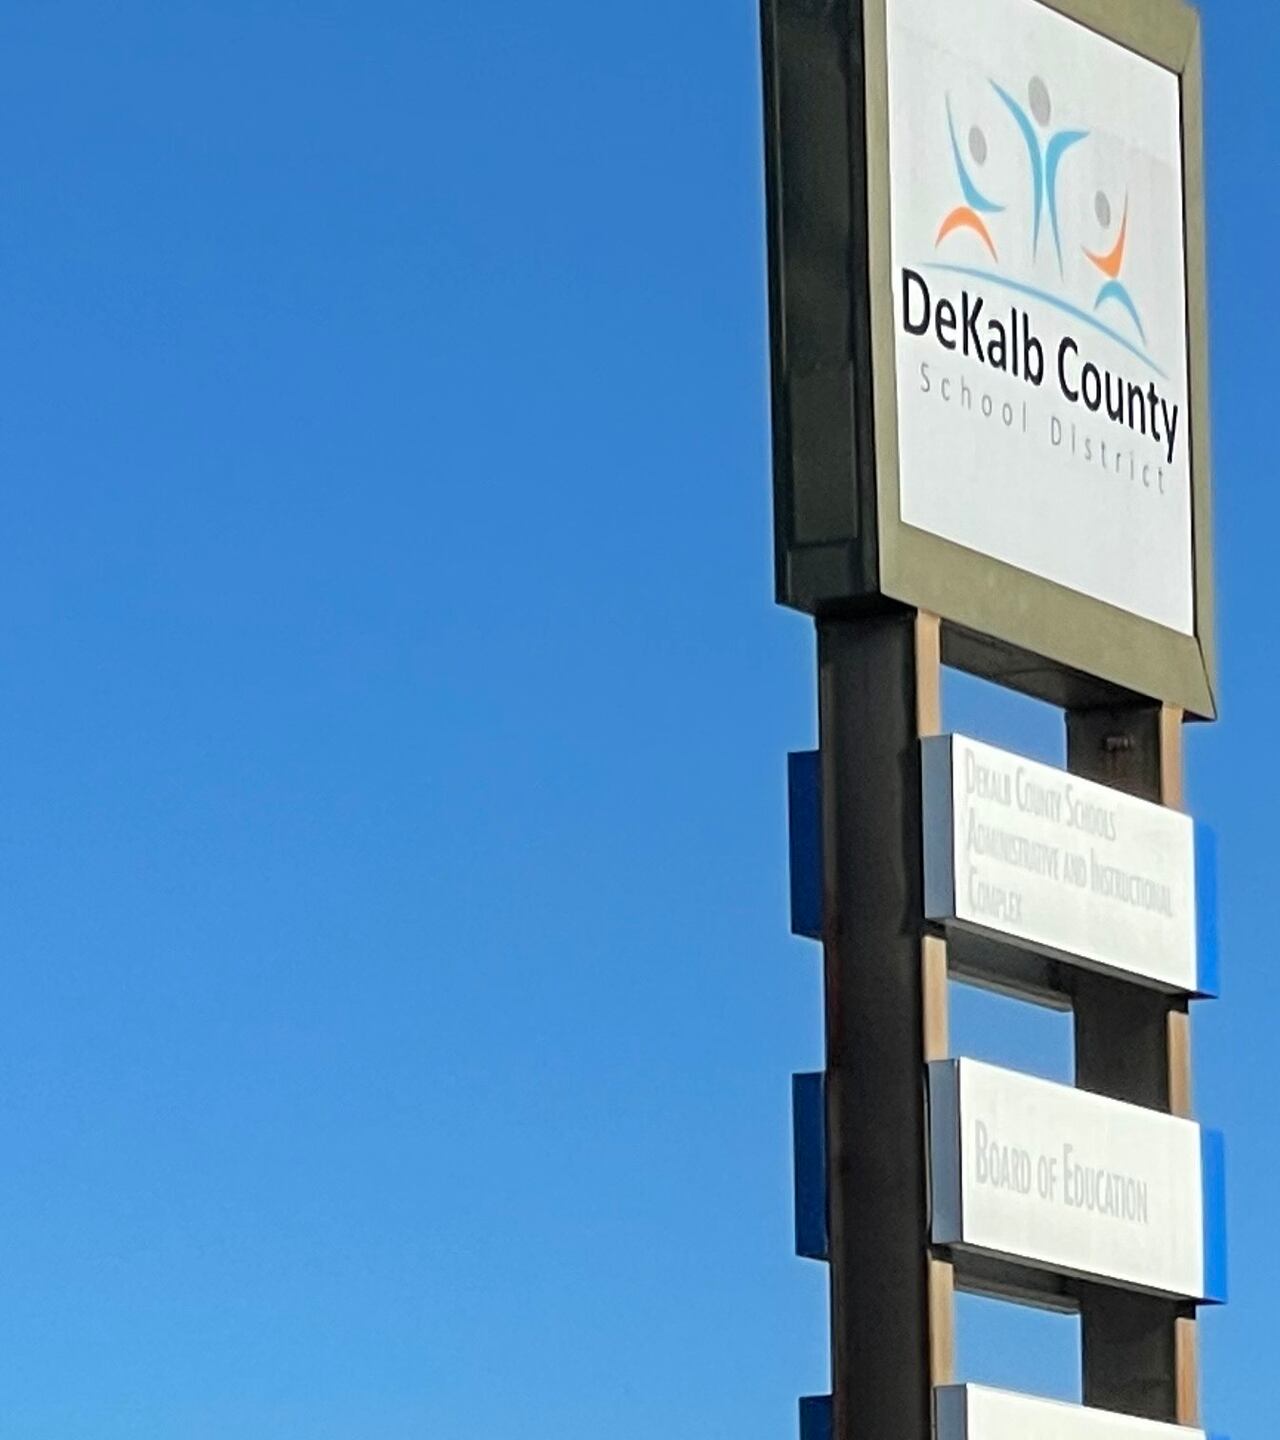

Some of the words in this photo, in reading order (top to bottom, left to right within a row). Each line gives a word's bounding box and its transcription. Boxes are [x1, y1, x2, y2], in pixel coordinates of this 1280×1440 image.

[902, 267, 1044, 387] DeKalb
[1057, 336, 1178, 463] County
[920, 361, 1028, 433] School
[1051, 415, 1166, 496] District
[975, 1119, 1031, 1194] BOARD
[1037, 1154, 1057, 1203] OF
[1063, 1143, 1148, 1224] EDUCATION
